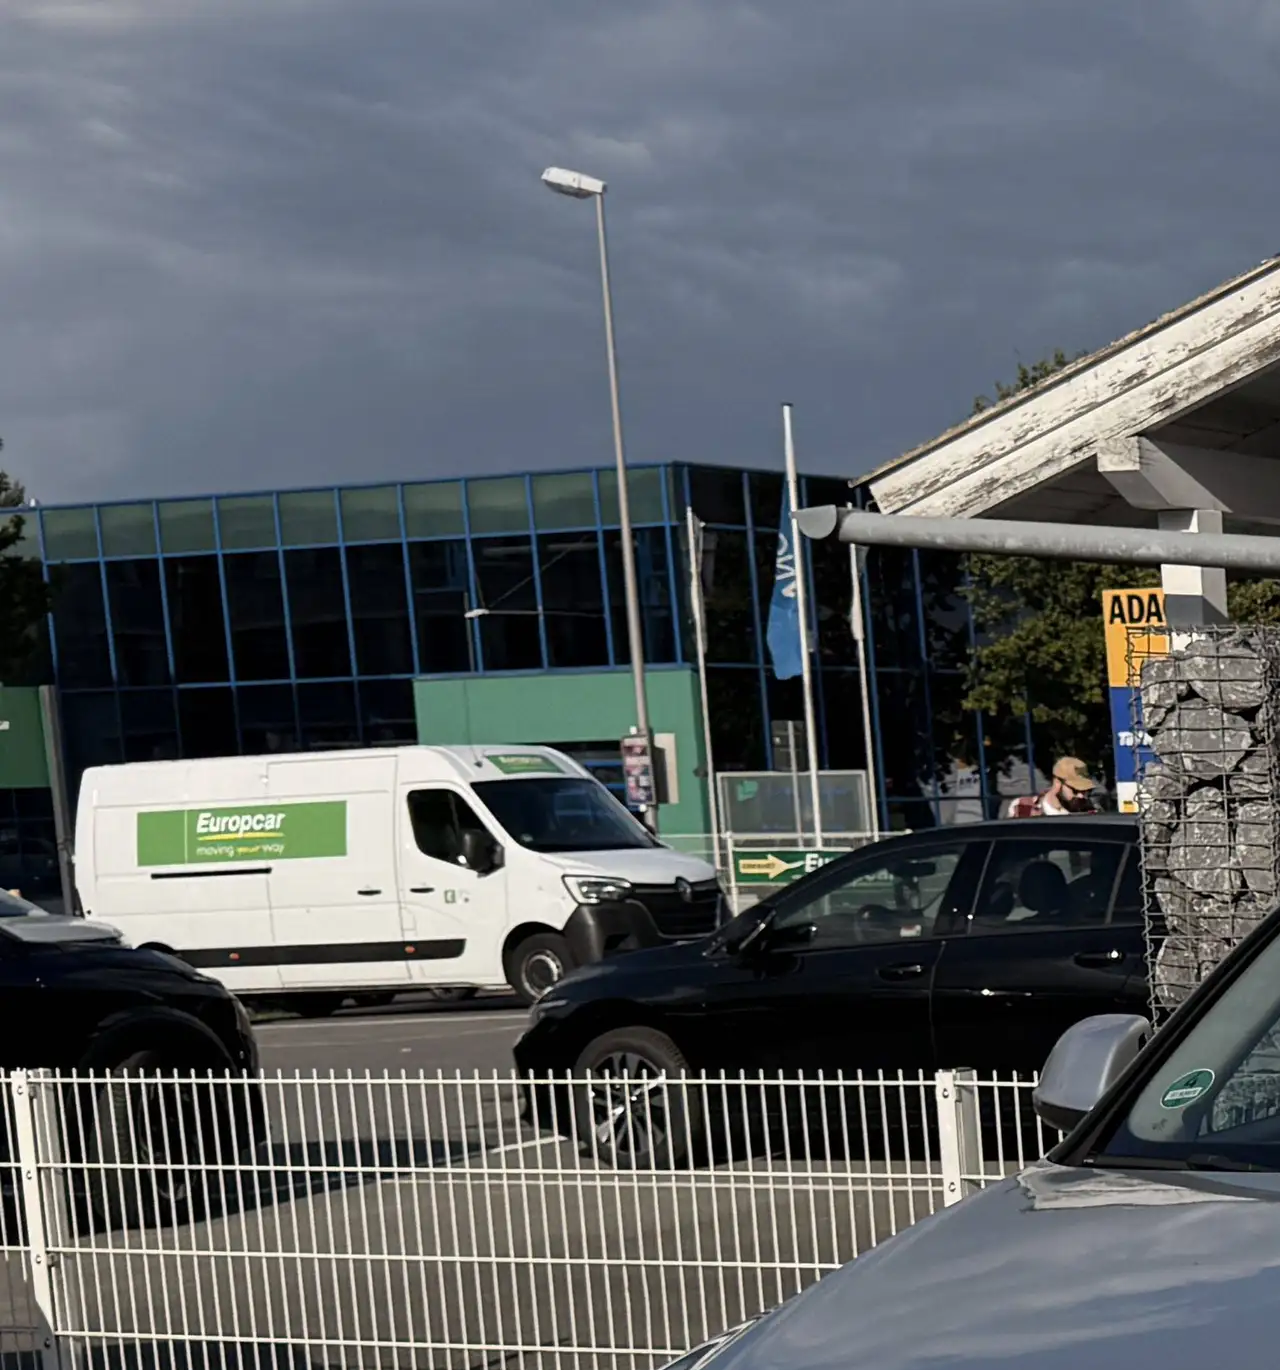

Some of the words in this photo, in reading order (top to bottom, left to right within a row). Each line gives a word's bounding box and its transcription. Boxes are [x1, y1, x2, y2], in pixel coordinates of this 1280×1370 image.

[1109, 593, 1165, 625] ADA
[196, 812, 286, 834] Europcar
[196, 845, 235, 857] moving
[261, 844, 285, 856] way
